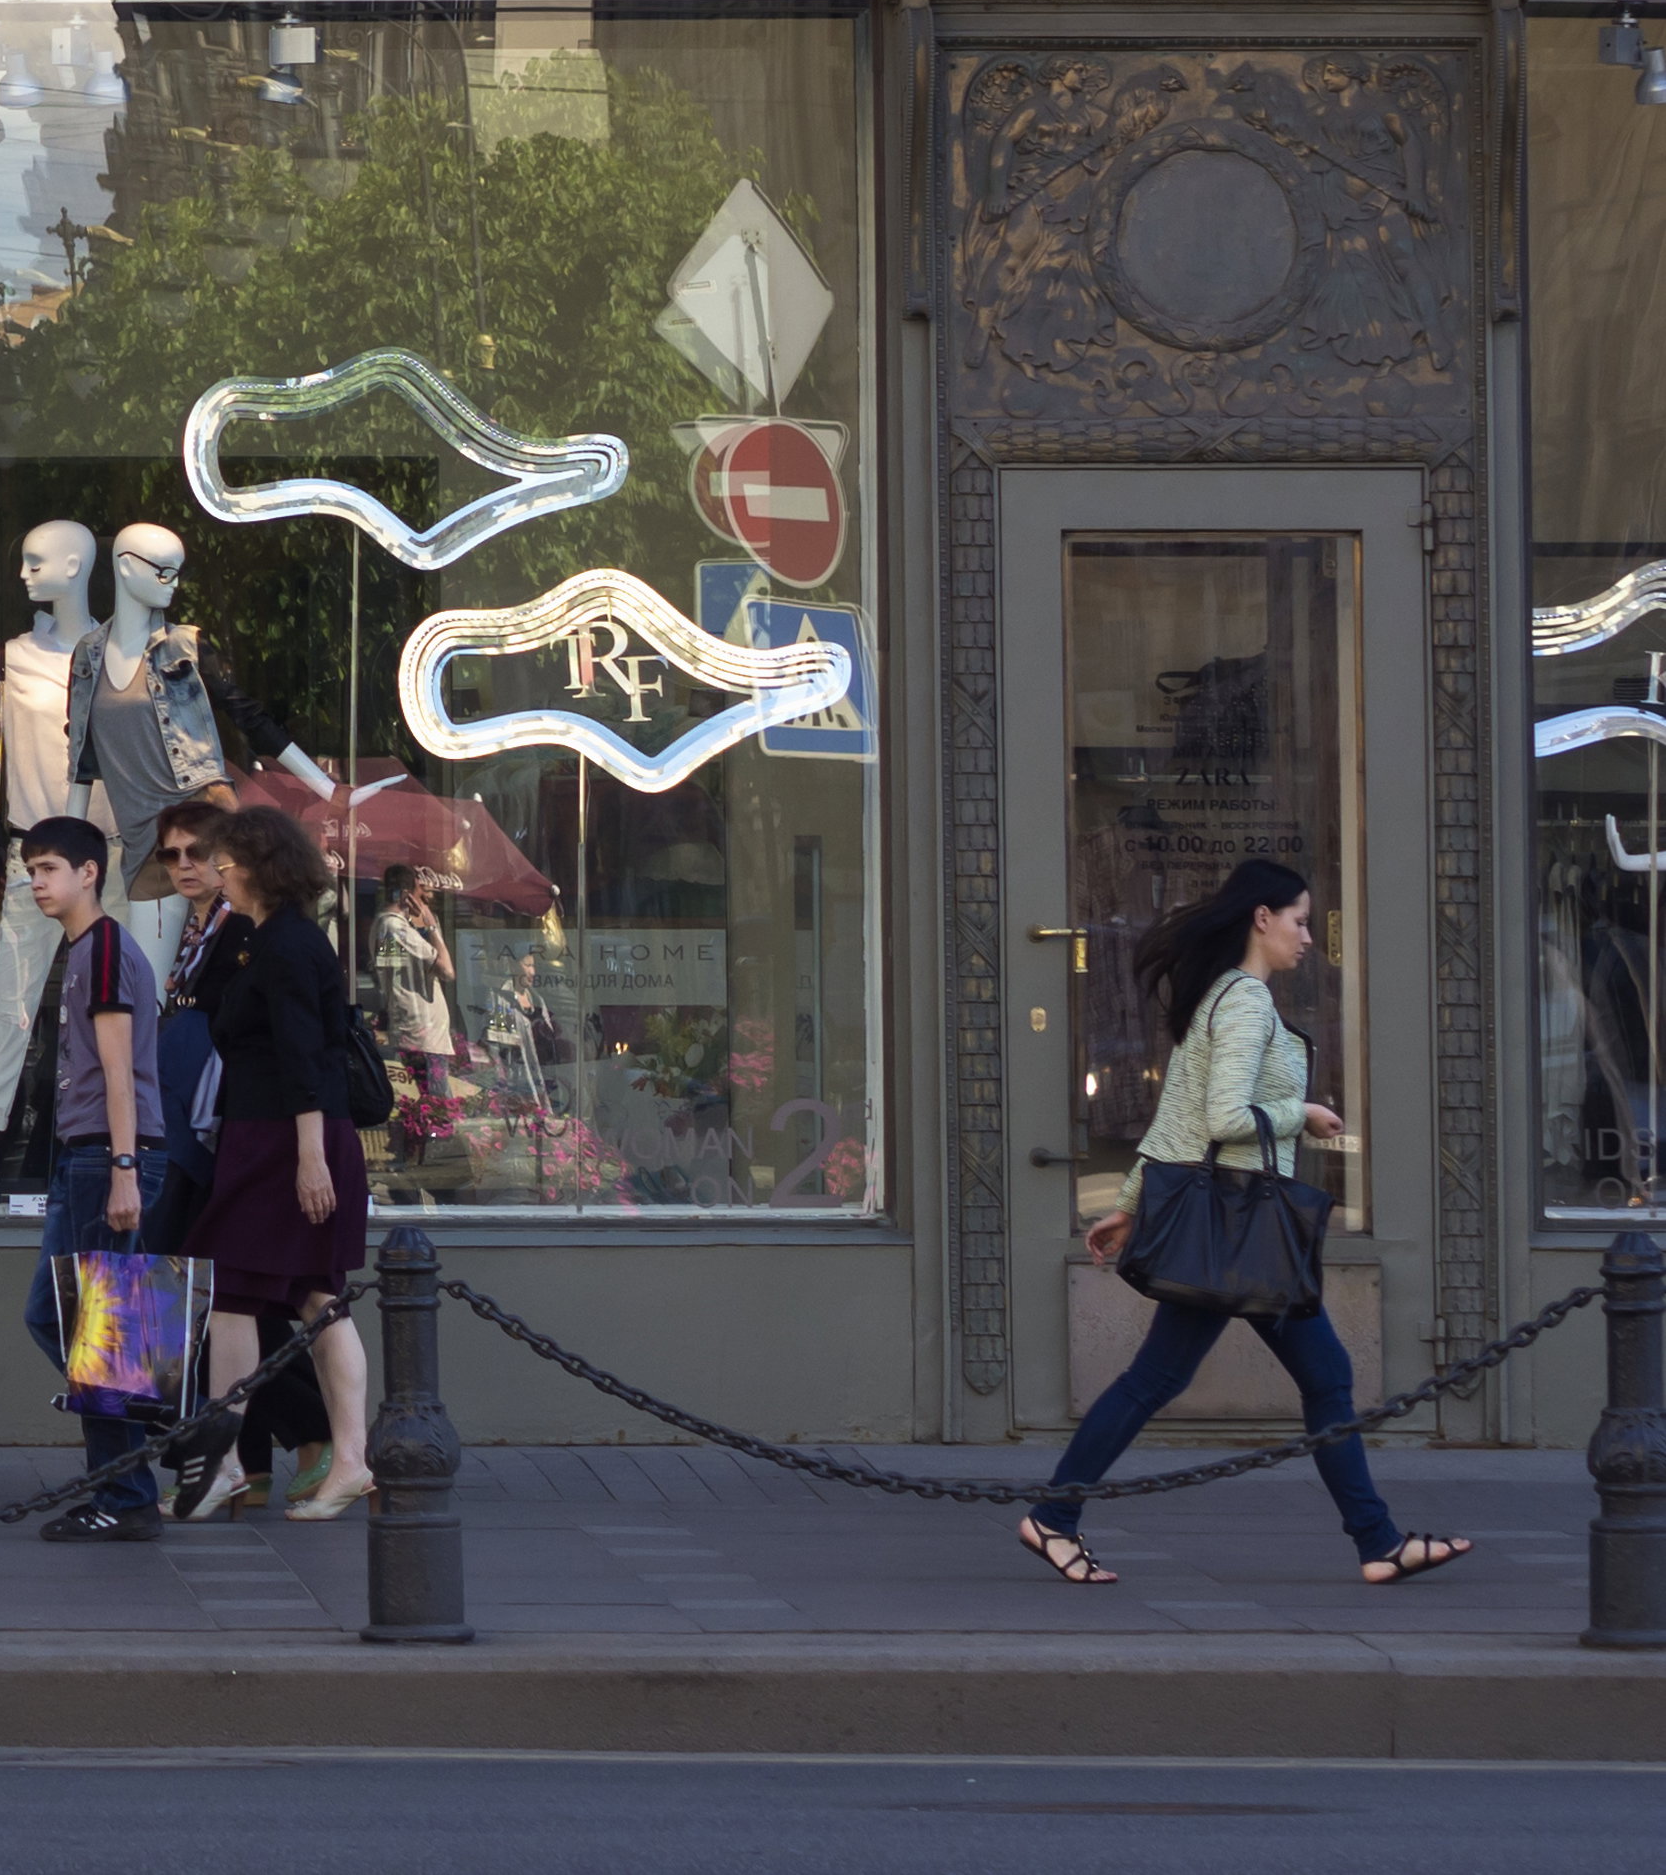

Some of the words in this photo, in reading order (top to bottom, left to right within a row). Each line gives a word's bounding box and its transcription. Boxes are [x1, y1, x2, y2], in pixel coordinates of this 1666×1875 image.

[550, 622, 669, 723] TRF
[1175, 767, 1251, 786] ZARA
[1147, 799, 1205, 811] РЕЖИМ
[1145, 836, 1204, 853] 10.00
[1210, 839, 1235, 854] до
[1244, 836, 1304, 853] 22.00
[471, 944, 576, 961] ZARA
[600, 944, 715, 961] HOME
[510, 974, 579, 989] ТОВАРЫ
[584, 973, 618, 991] ДЛЯ
[621, 973, 674, 991] ДОМА
[691, 1175, 754, 1209] ON
